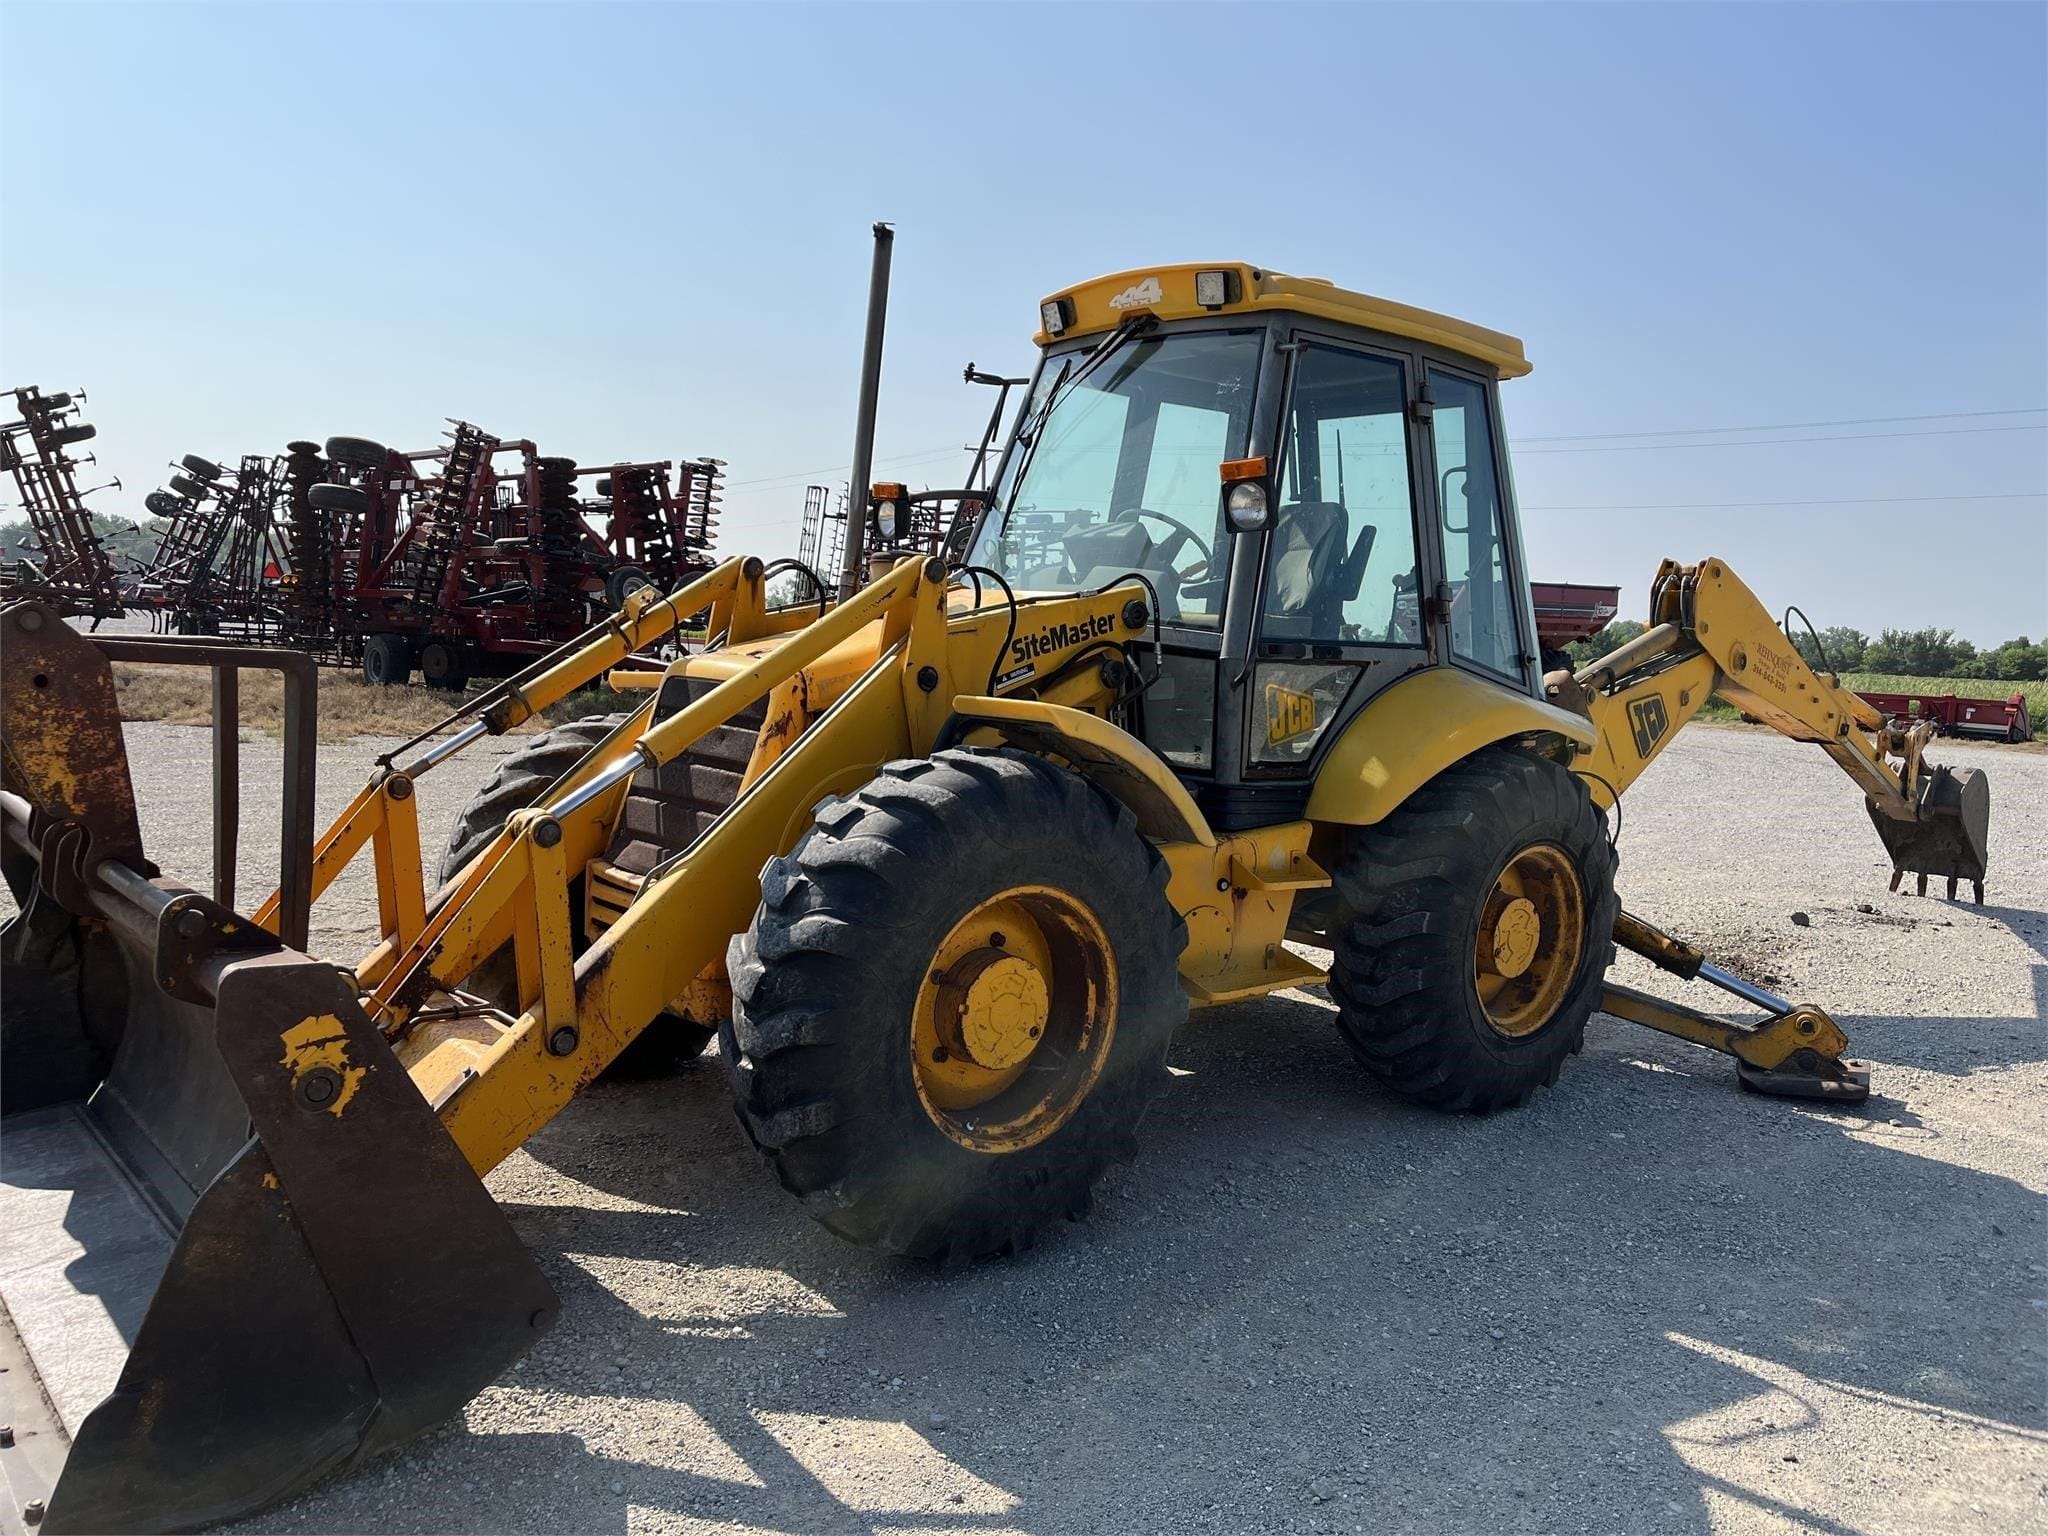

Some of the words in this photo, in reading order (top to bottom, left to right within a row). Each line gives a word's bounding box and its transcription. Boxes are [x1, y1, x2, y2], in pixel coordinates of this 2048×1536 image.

[1011, 613, 1116, 664] SiteMaster
[1270, 690, 1313, 740] JCB
[1632, 698, 1667, 757] JCB
